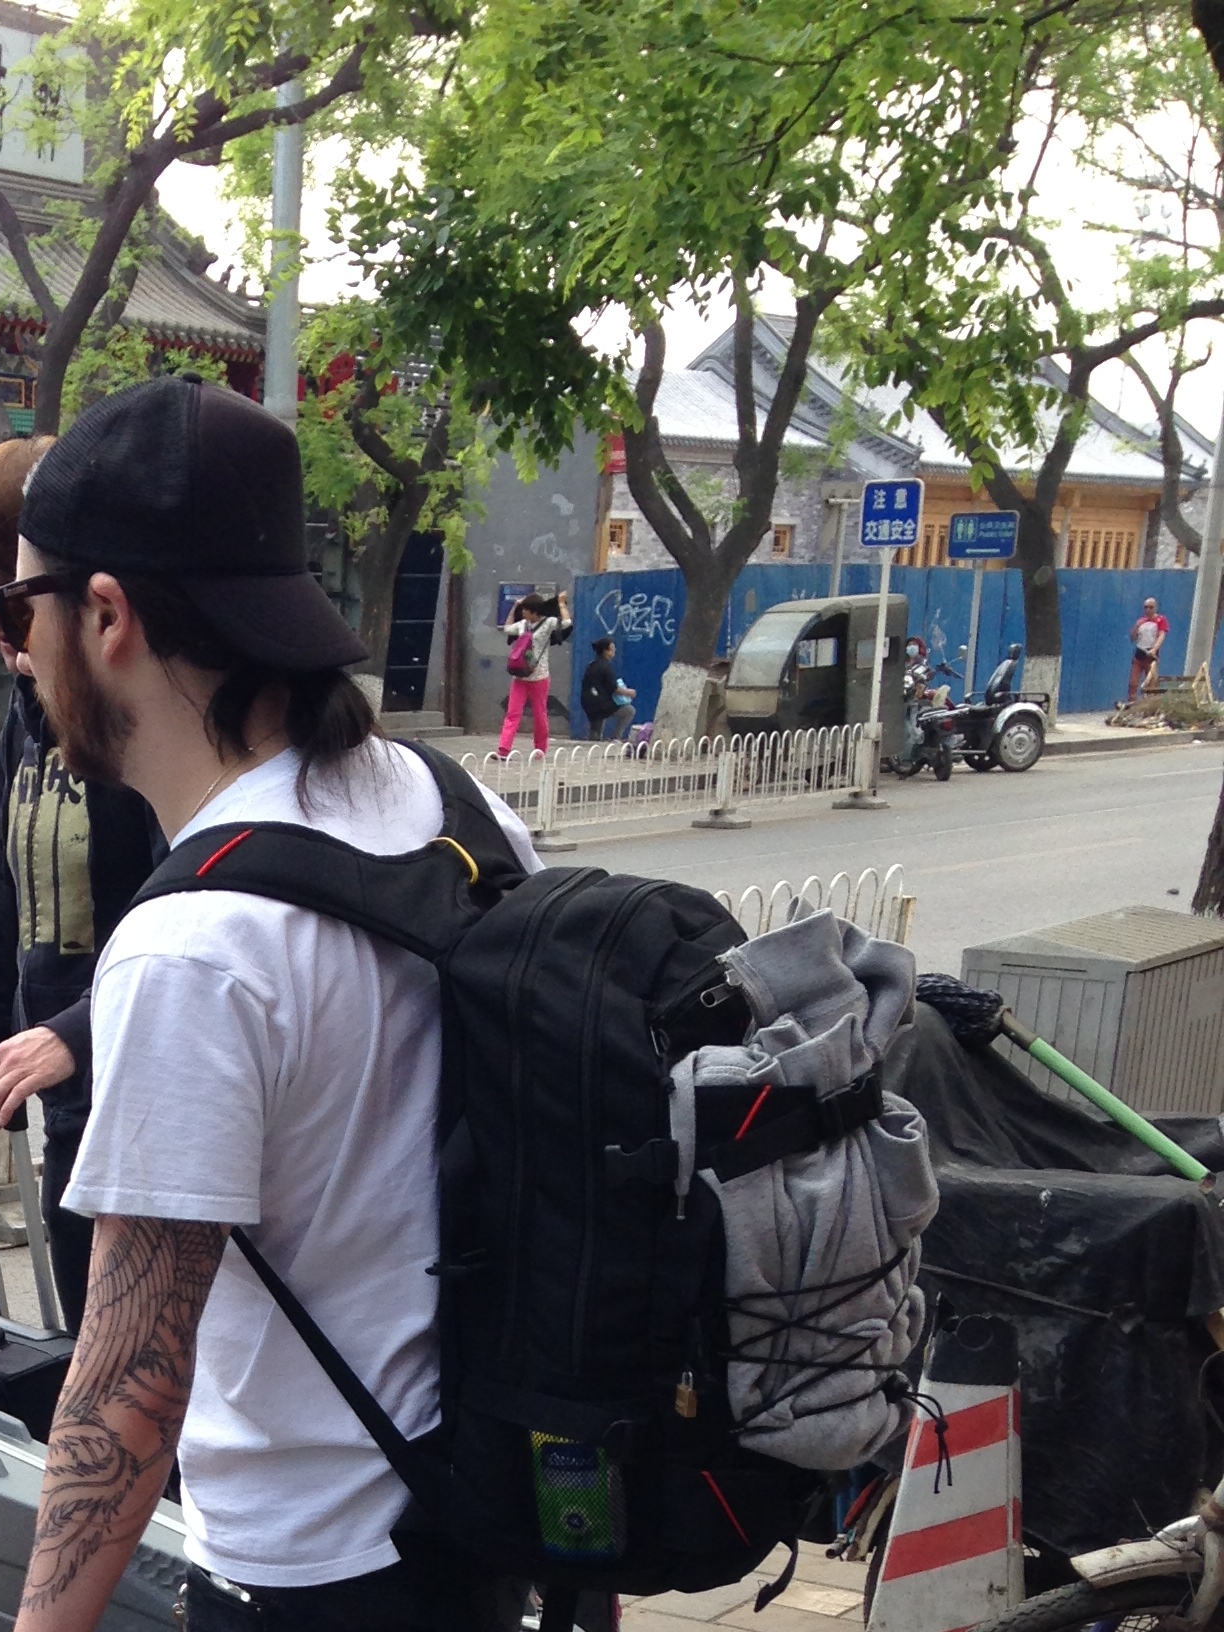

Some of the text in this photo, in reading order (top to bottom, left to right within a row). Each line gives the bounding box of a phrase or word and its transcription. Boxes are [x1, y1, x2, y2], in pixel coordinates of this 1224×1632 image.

[873, 488, 907, 510] 注意
[865, 519, 916, 541] 交通安全
